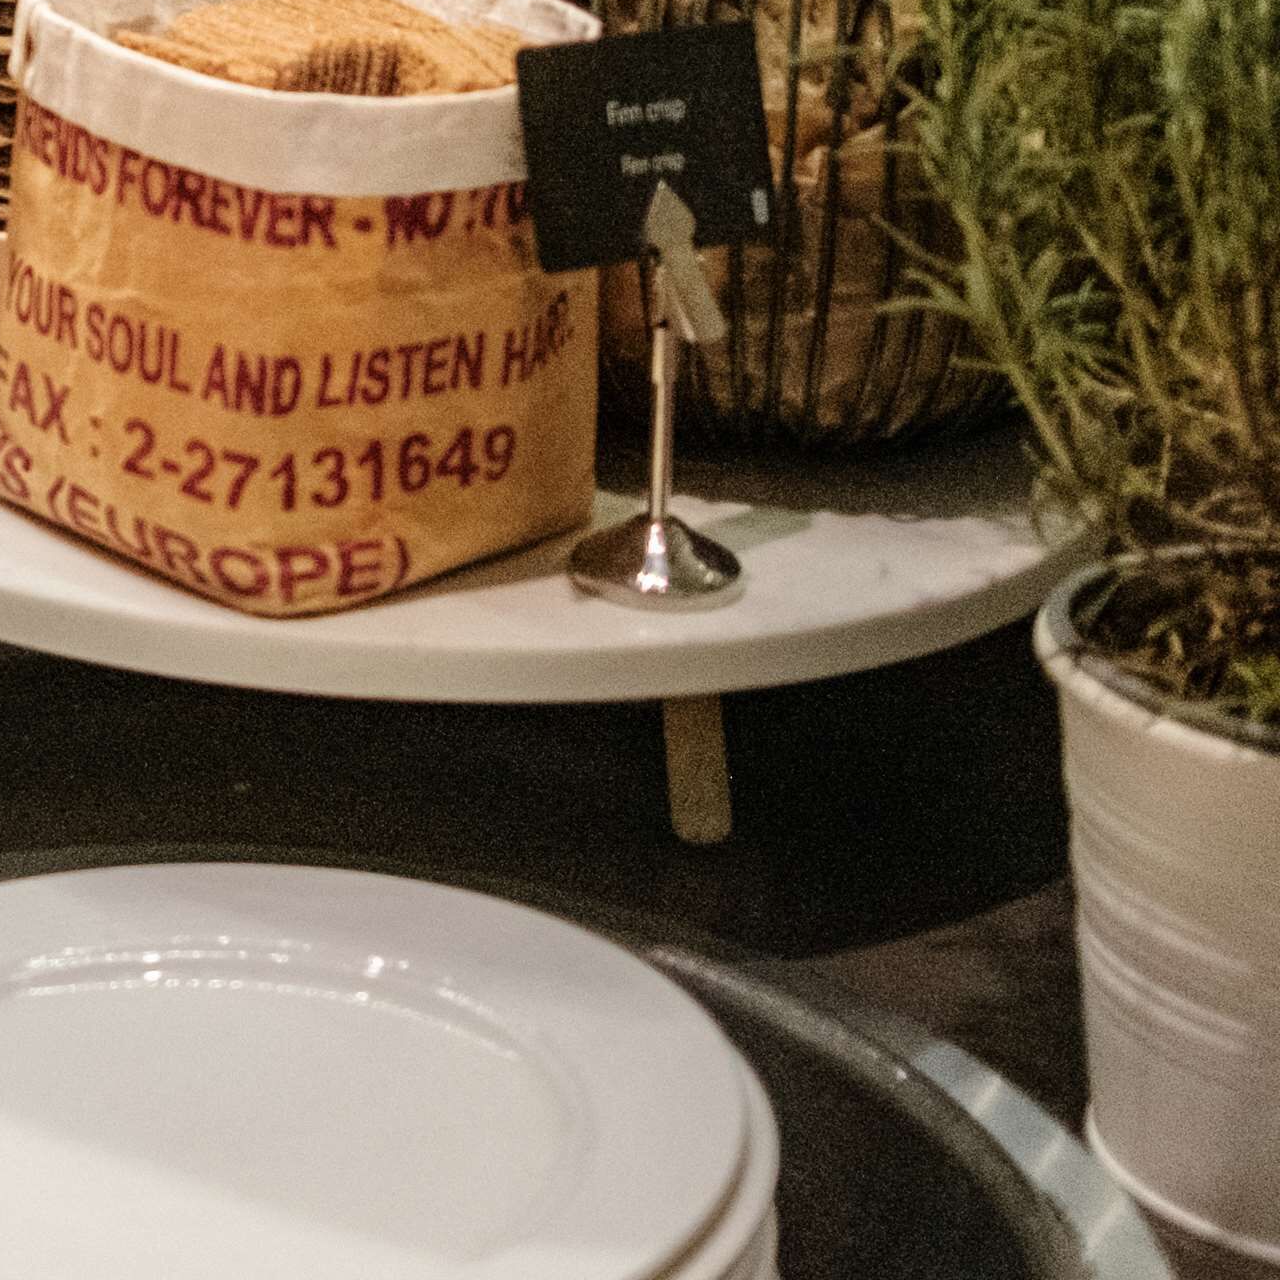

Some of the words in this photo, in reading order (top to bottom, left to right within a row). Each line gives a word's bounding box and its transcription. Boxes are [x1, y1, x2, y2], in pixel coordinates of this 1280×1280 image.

[116, 147, 336, 249] FOREVER
[5, 251, 78, 349] YOUR
[86, 302, 190, 392] SOUL
[201, 345, 302, 417] AND
[317, 331, 487, 408] LISTEN
[120, 419, 517, 514] 2-27131649
[47, 470, 411, 604] (EUROPE)
